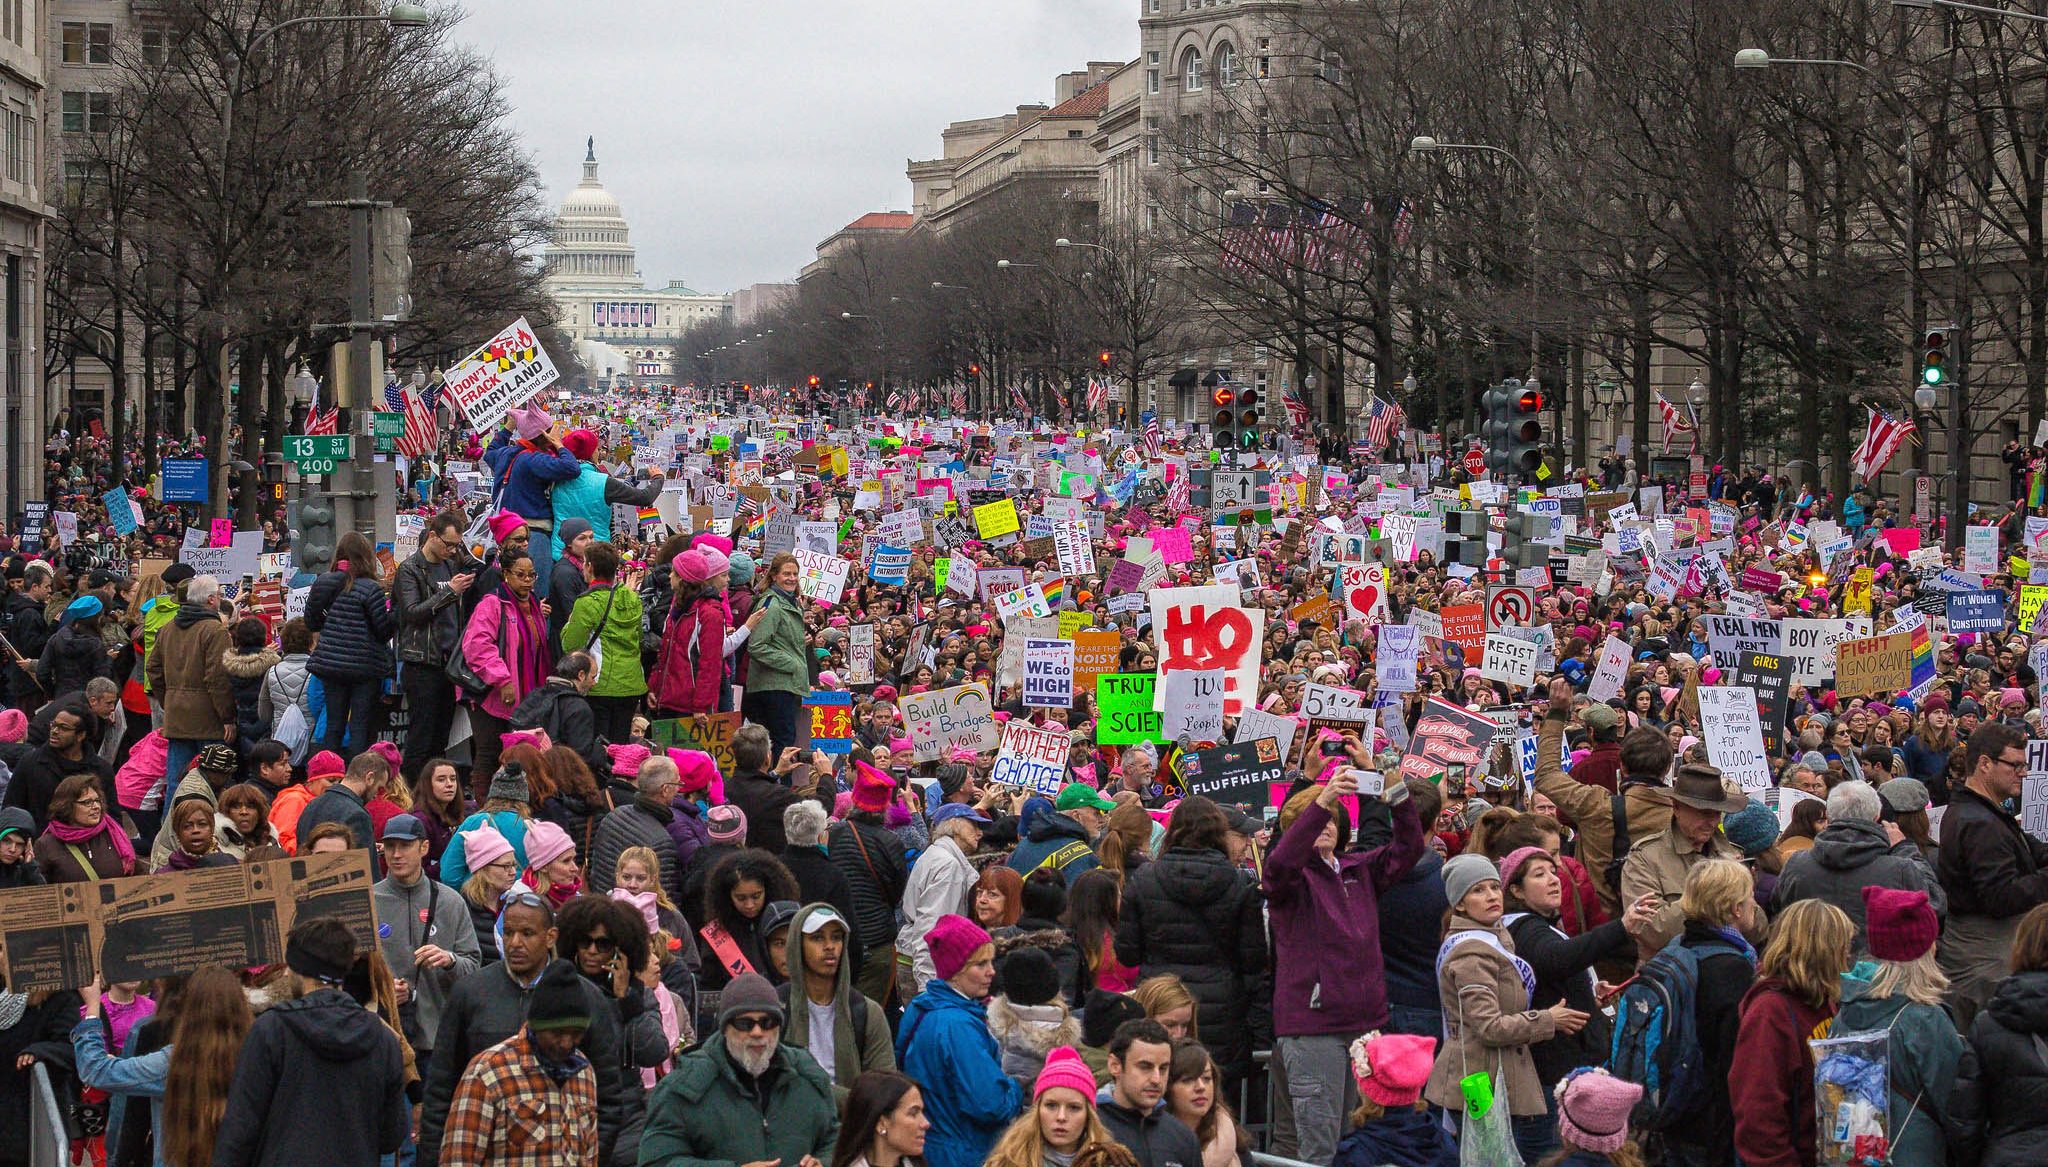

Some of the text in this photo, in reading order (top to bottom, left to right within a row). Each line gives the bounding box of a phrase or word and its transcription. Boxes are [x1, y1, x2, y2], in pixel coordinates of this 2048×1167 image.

[454, 365, 488, 396] DON'T
[460, 373, 502, 407] FRACK
[468, 360, 542, 420] MARYLAND
[476, 368, 556, 428] www.dontfrackmd.org
[292, 438, 314, 456] 13
[302, 460, 333, 472] 400
[1216, 475, 1234, 483] THRU
[276, 484, 281, 498] 8
[1530, 501, 1559, 512] VOTED
[1612, 510, 1623, 519] WE
[878, 525, 894, 533] MEN
[1384, 515, 1417, 531] SEXISM
[1395, 532, 1414, 545] NOT
[1054, 522, 1072, 575] WE WILL ACT
[1784, 544, 1798, 554] LOVE
[1825, 542, 1848, 553] TRUMP
[795, 550, 846, 576] PUSSIES
[1215, 564, 1232, 573] 007
[1661, 558, 1680, 574] IMPEACH
[1696, 557, 1712, 569] We
[1655, 566, 1678, 587] GROPER
[987, 583, 1019, 595] TRUTH
[1001, 586, 1034, 607] LOVE
[1952, 595, 1996, 605] PUT WOMEN
[1457, 615, 1482, 623] FUTURE
[1897, 608, 1912, 619] WE
[1444, 624, 1483, 636] IS STILL
[1712, 618, 1780, 638] REAL MEN
[1888, 624, 1905, 635] THIS
[1914, 614, 1923, 626] MY
[1951, 618, 2002, 629] CONSTITUTION
[1790, 629, 1818, 647] BOY
[1488, 640, 1534, 660] RESIST
[1735, 640, 1768, 652] AREN'T
[1840, 637, 1890, 659] FIGHT
[1074, 654, 1118, 664] NOISY
[1490, 656, 1528, 676] HATE
[1752, 655, 1779, 670] GIRLS
[1841, 650, 1912, 676] IGNORANCE
[1027, 661, 1070, 675] WE GO
[1600, 670, 1619, 682] WITH
[1742, 673, 1782, 687] JUST WANT
[1026, 678, 1070, 694] HIGH
[1758, 689, 1774, 699] HAVE
[907, 698, 948, 722] Build
[1722, 712, 1750, 722] Donald
[939, 711, 993, 732] Bridges
[1182, 716, 1220, 732] People
[672, 720, 729, 744] LOVE
[1418, 724, 1469, 740] OUR BODIES
[1724, 725, 1750, 734] Trump
[913, 740, 937, 752] NOT
[1002, 725, 1070, 764] MOTHER
[1014, 752, 1034, 762] BY
[1427, 743, 1475, 762] OUR MINDS
[1404, 758, 1429, 773] OUR
[993, 757, 1062, 793] CHOICE
[1192, 769, 1280, 794] FLUFFHEAD
[1058, 850, 1072, 860] ACT
